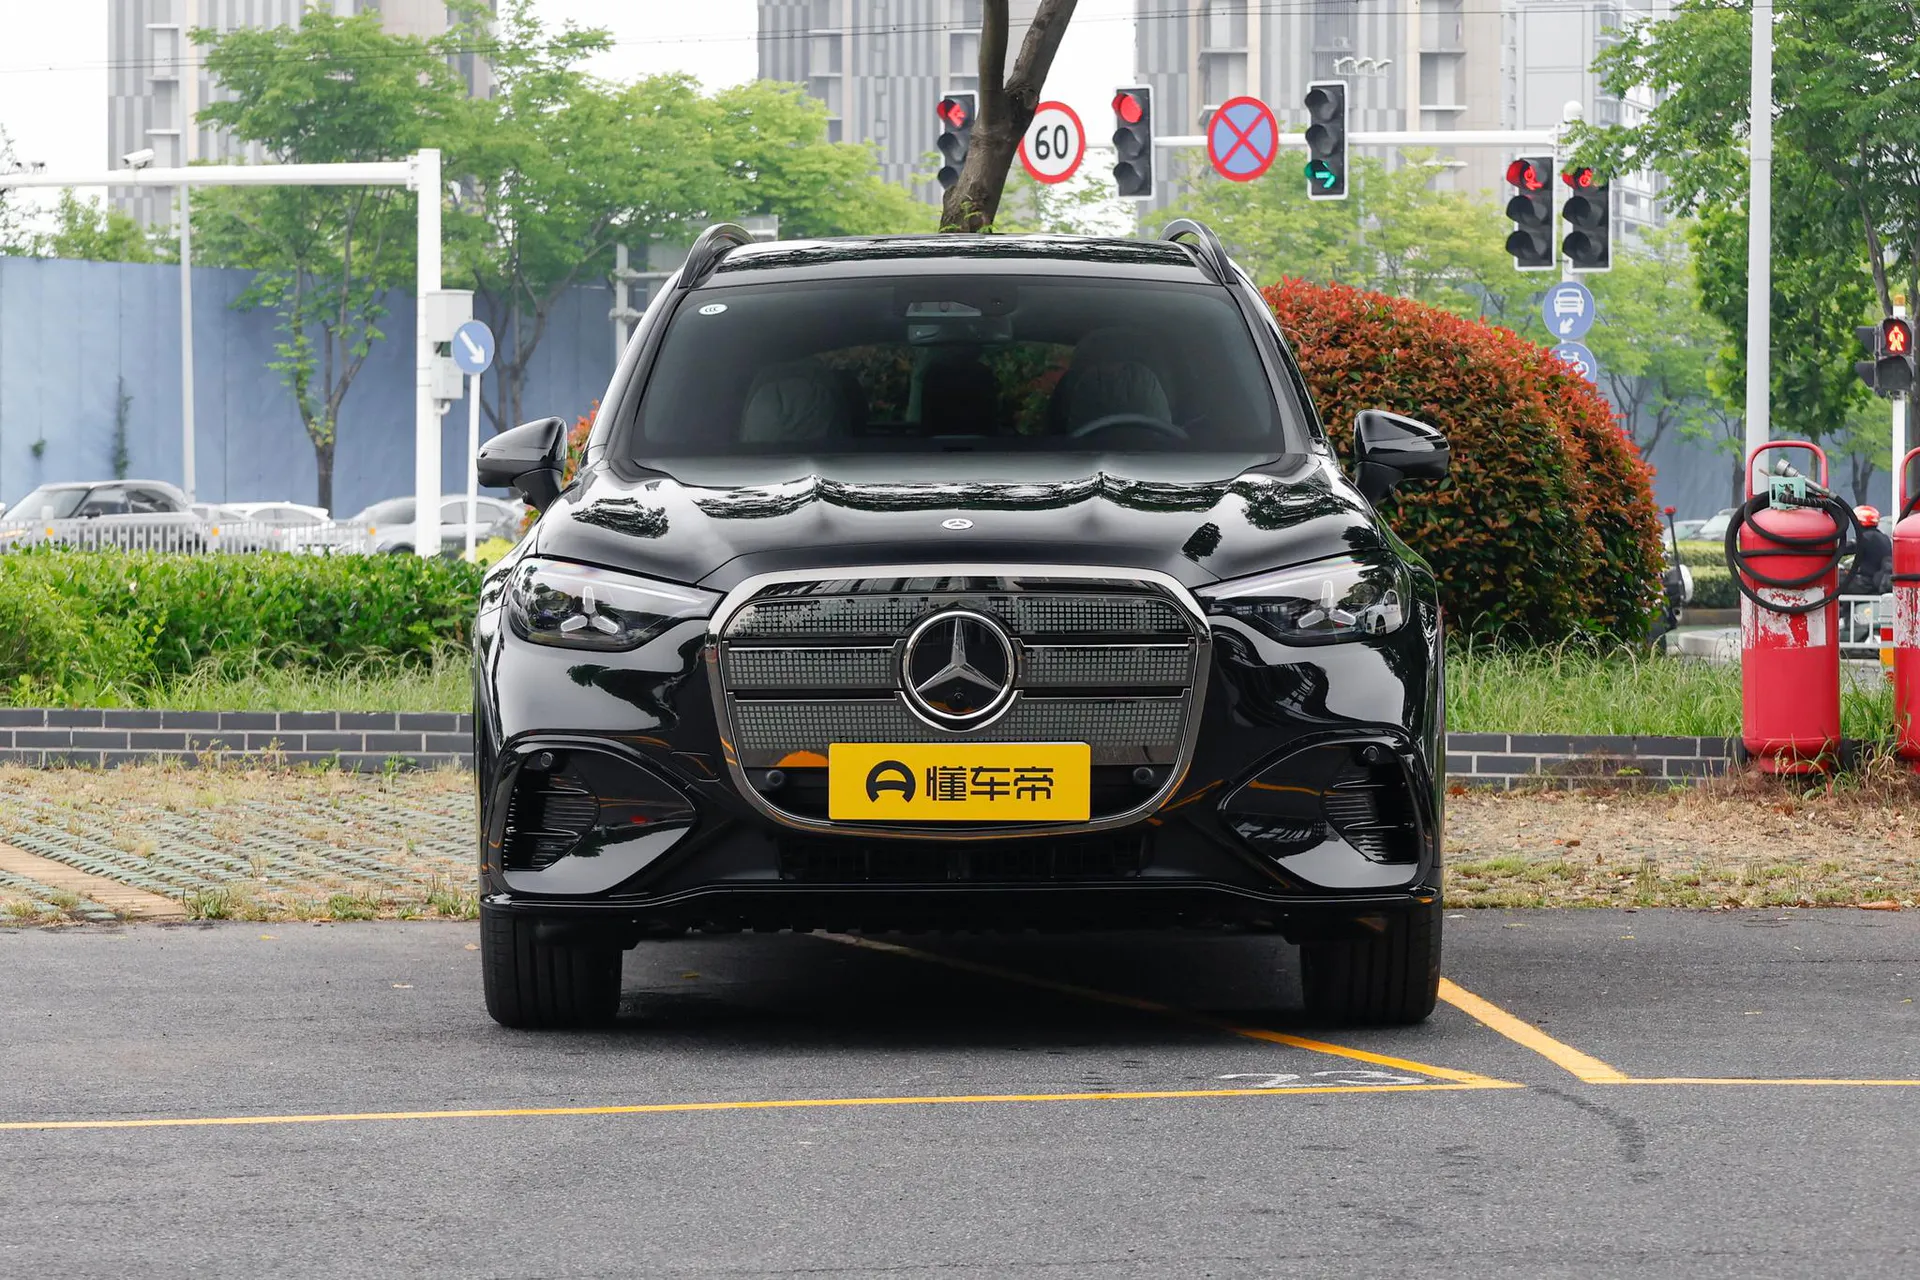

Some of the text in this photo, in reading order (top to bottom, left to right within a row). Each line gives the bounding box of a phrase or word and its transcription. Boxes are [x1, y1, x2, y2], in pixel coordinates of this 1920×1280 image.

[1035, 124, 1068, 160] 60
[926, 765, 1054, 801] 懂车帝
[1217, 1070, 1425, 1088] 23
